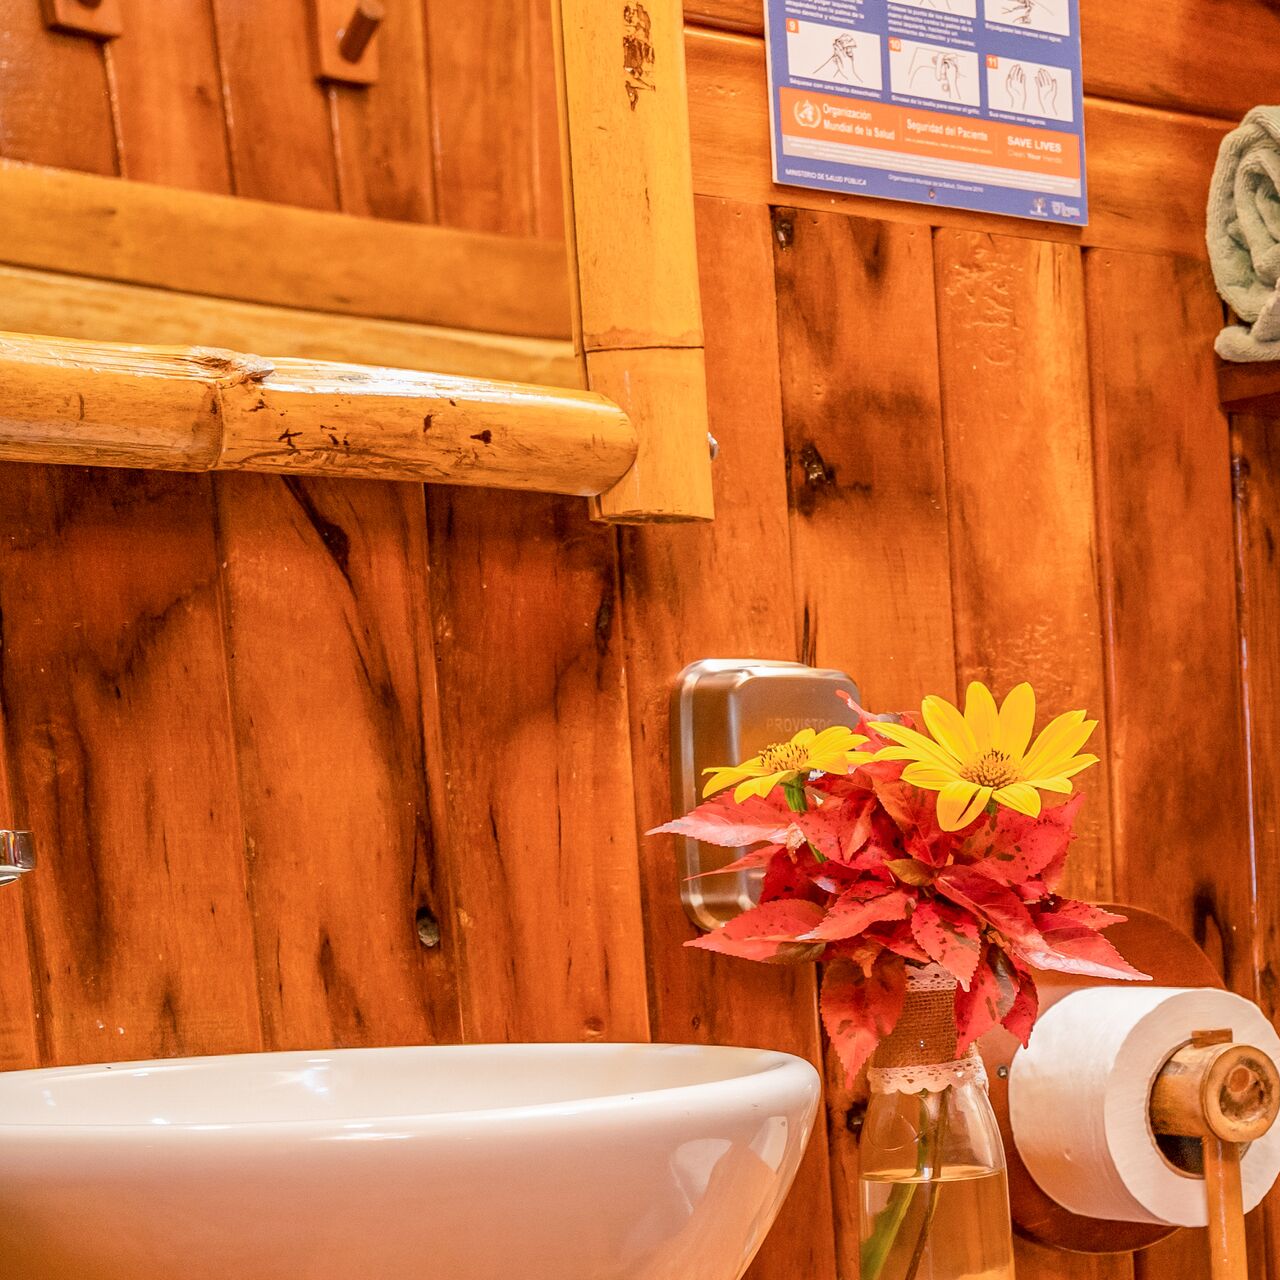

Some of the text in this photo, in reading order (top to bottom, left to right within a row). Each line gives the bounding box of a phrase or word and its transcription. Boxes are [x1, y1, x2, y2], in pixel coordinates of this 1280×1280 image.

[790, 20, 796, 31] 9
[890, 38, 900, 51] 10
[988, 56, 998, 68] 11
[823, 103, 872, 120] Organización
[824, 119, 896, 140] Mundial de la Salud
[907, 118, 988, 141] Seguridad del Paciente
[1008, 135, 1033, 149] SAVE
[1034, 139, 1062, 154] LIVES
[785, 168, 817, 179] MINISTERIO
[825, 174, 844, 182] SALUD
